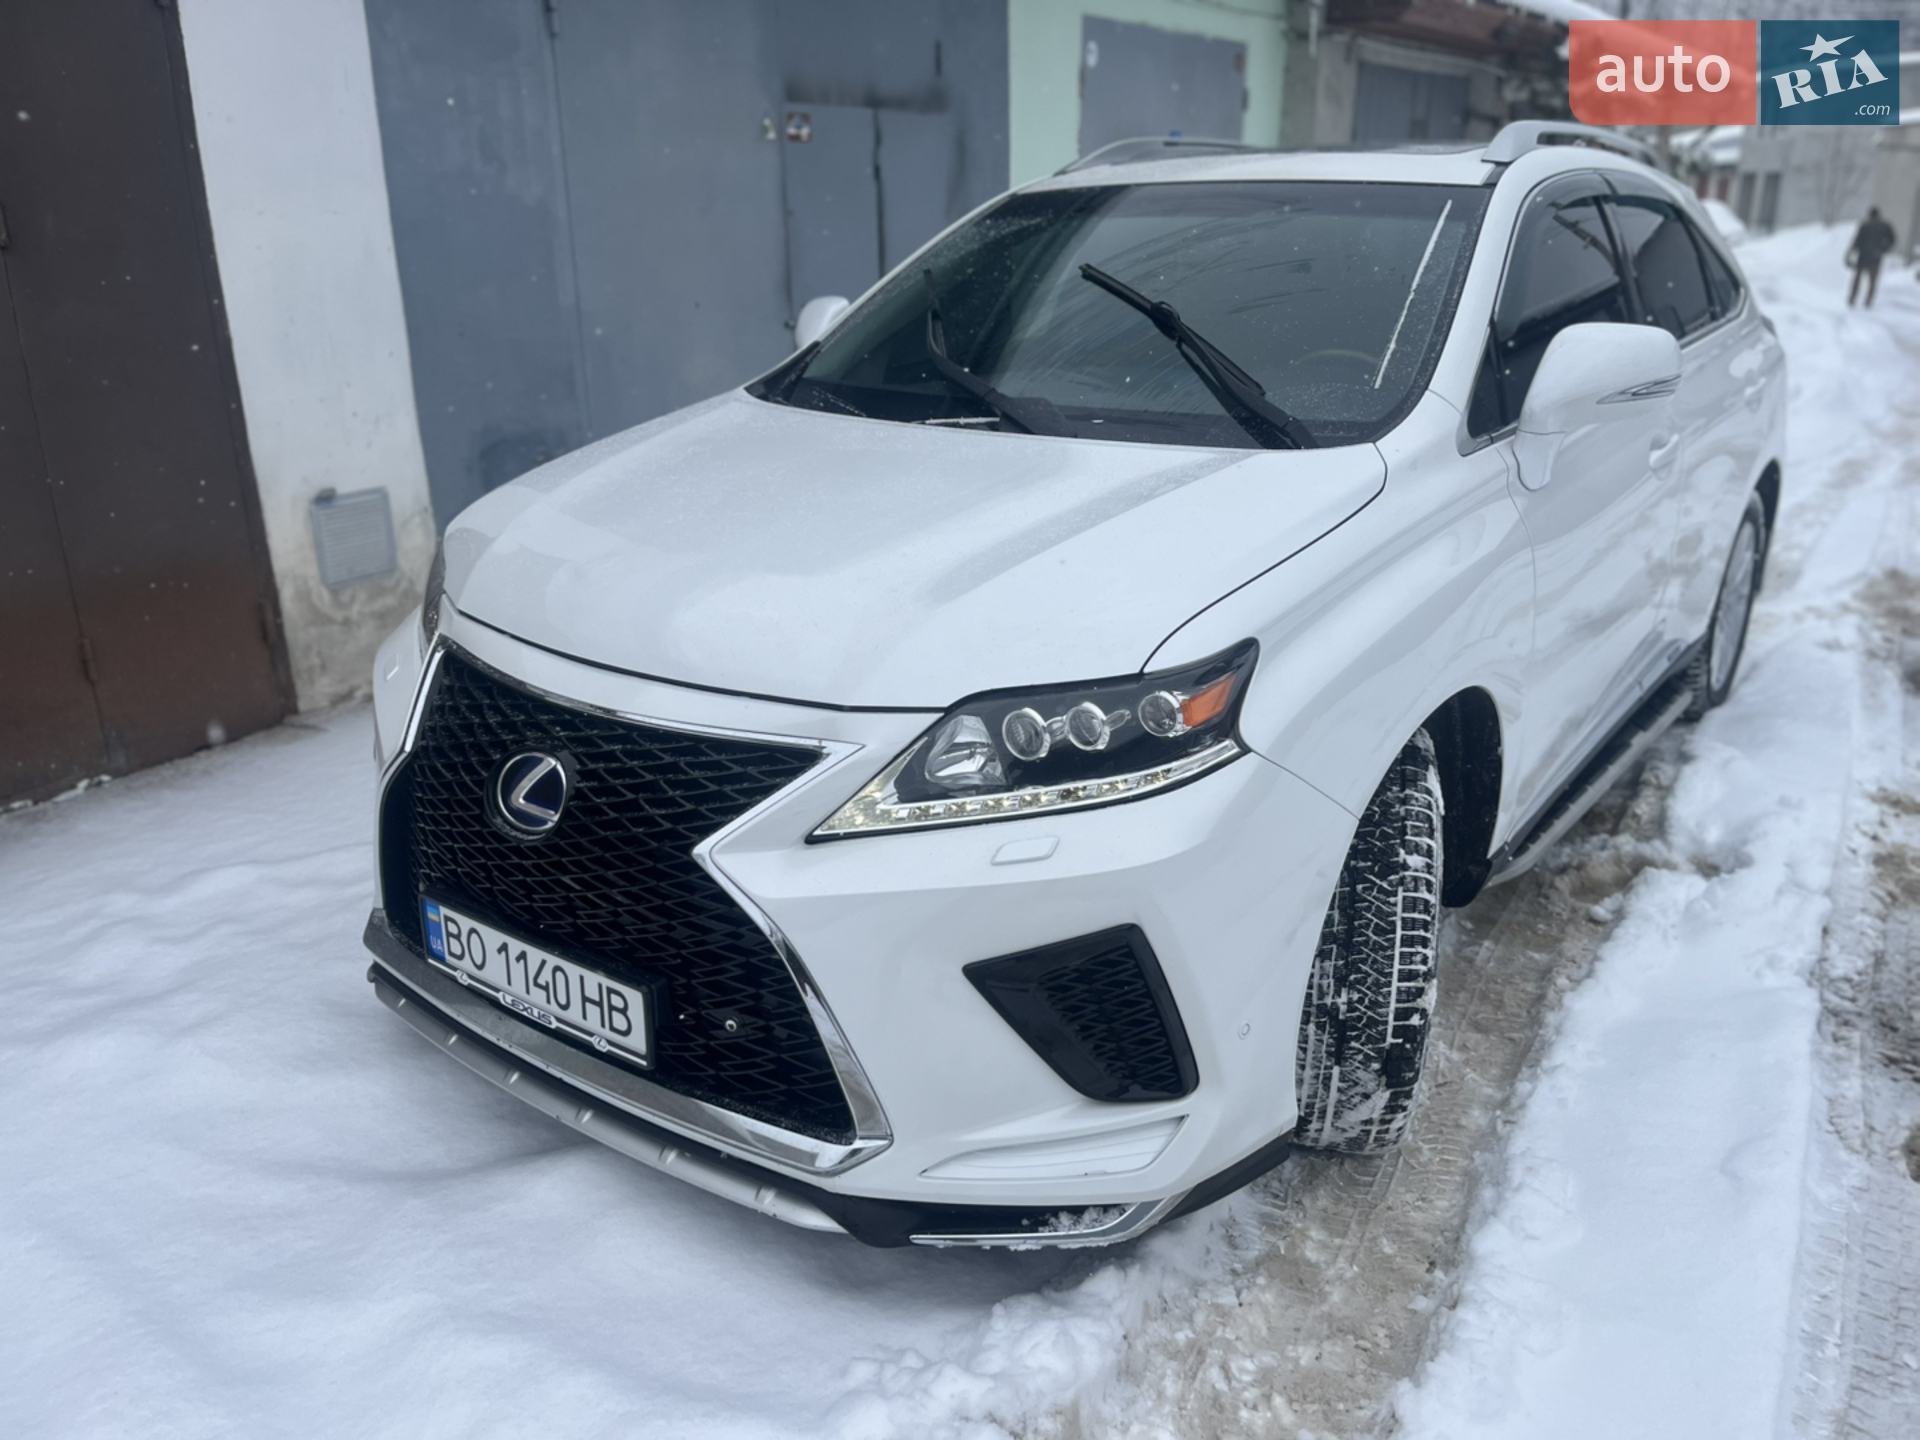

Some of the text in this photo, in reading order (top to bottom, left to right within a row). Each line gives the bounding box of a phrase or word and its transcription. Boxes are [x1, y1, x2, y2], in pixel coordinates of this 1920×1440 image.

[430, 935, 444, 953] UA
[443, 914, 633, 1037] BO 1140 HB
[502, 993, 554, 1026] LEXUS
